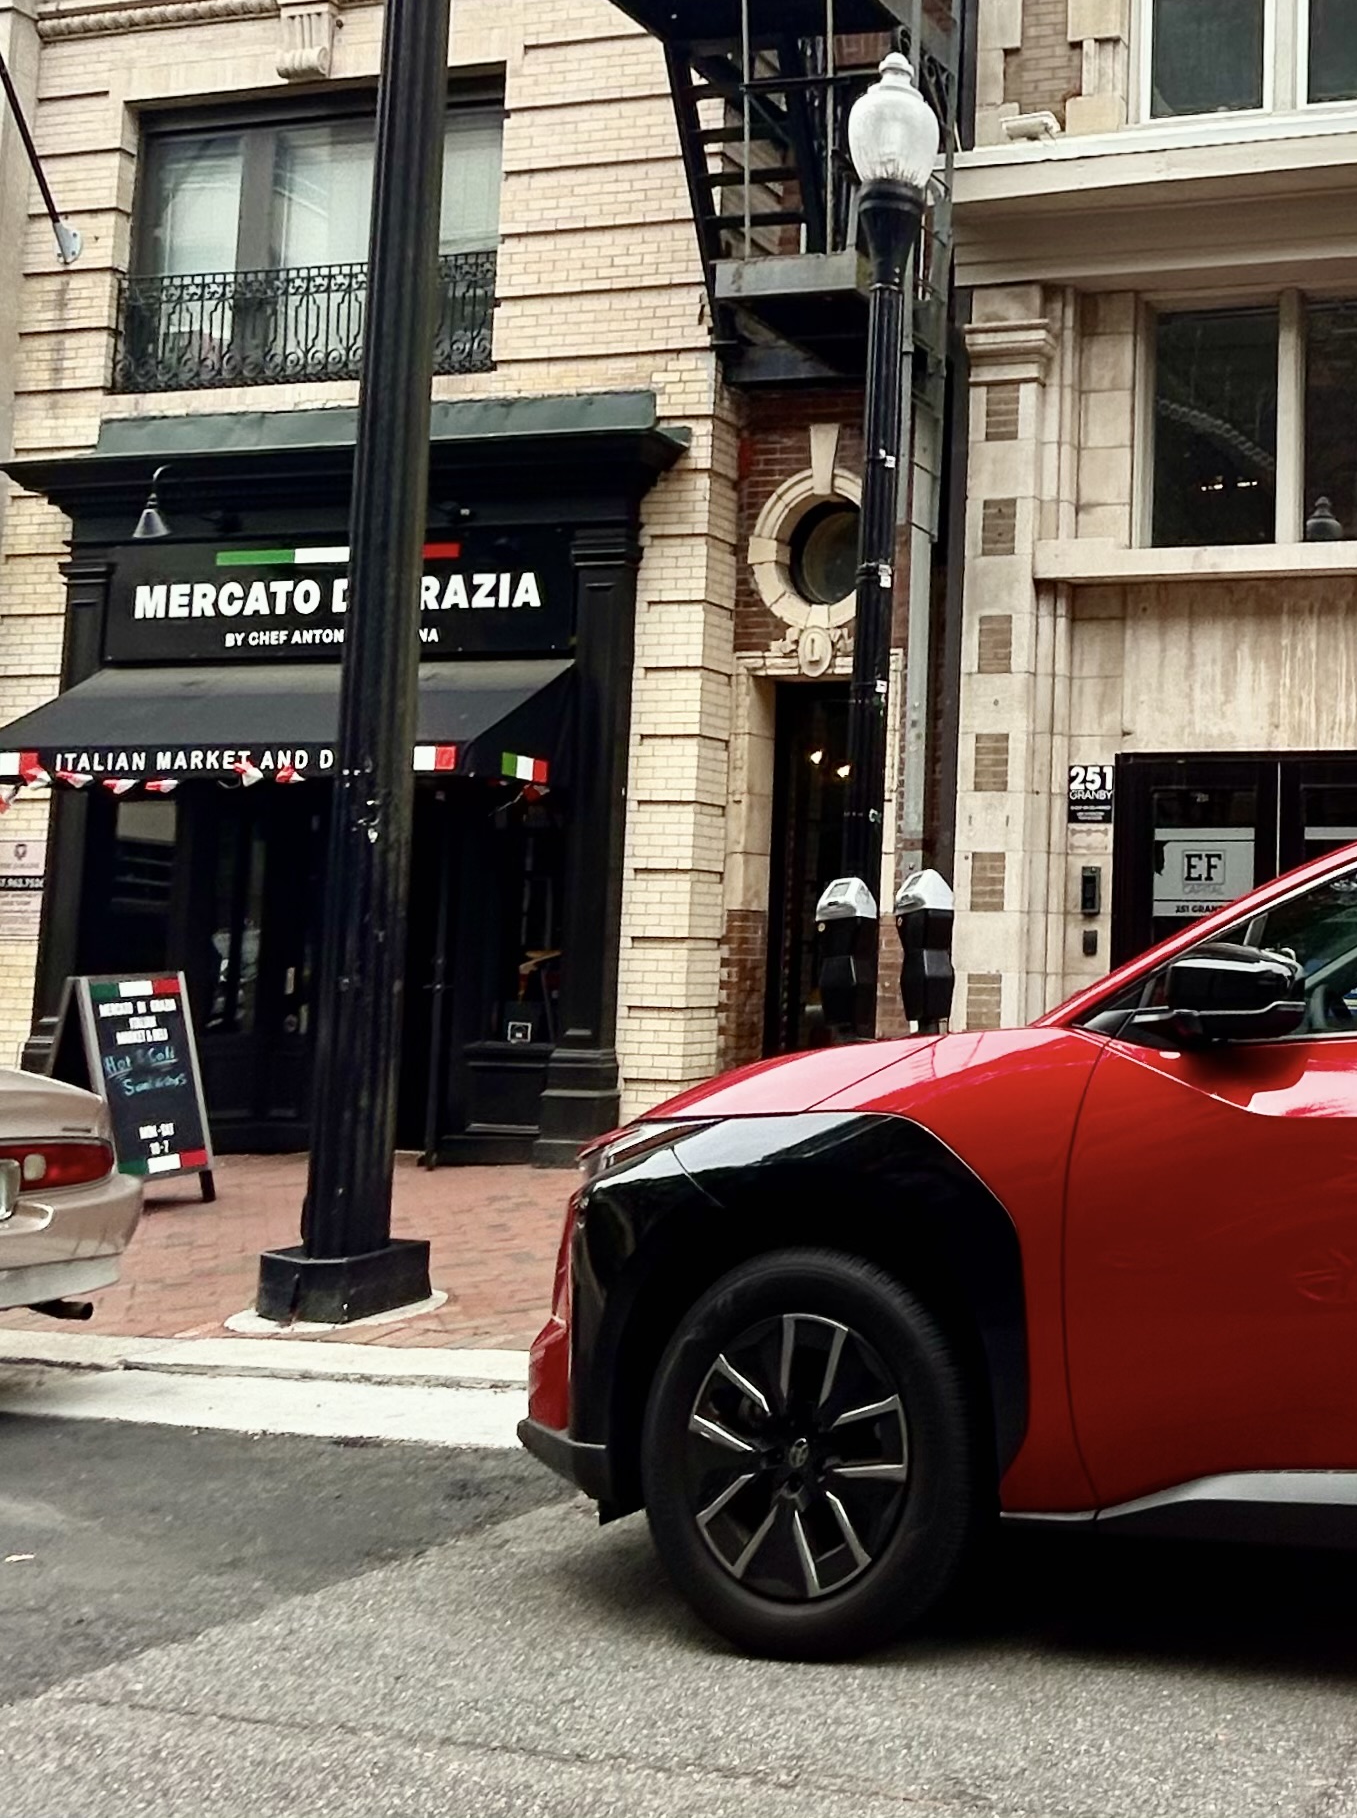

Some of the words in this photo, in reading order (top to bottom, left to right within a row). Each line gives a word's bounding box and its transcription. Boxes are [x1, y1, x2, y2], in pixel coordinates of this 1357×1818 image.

[134, 579, 321, 619] MERCATO
[420, 572, 541, 610] RAZIA
[225, 632, 245, 648] BY
[248, 630, 289, 646] CHEF
[291, 629, 345, 645] ANTON
[55, 751, 146, 772] ITALIAN
[156, 750, 251, 771] MARKET
[260, 749, 309, 770] AND
[1069, 766, 1113, 791] 251
[1069, 790, 1113, 800] GRANBY
[1185, 853, 1222, 881] EF
[1191, 905, 1224, 913] GRAN
